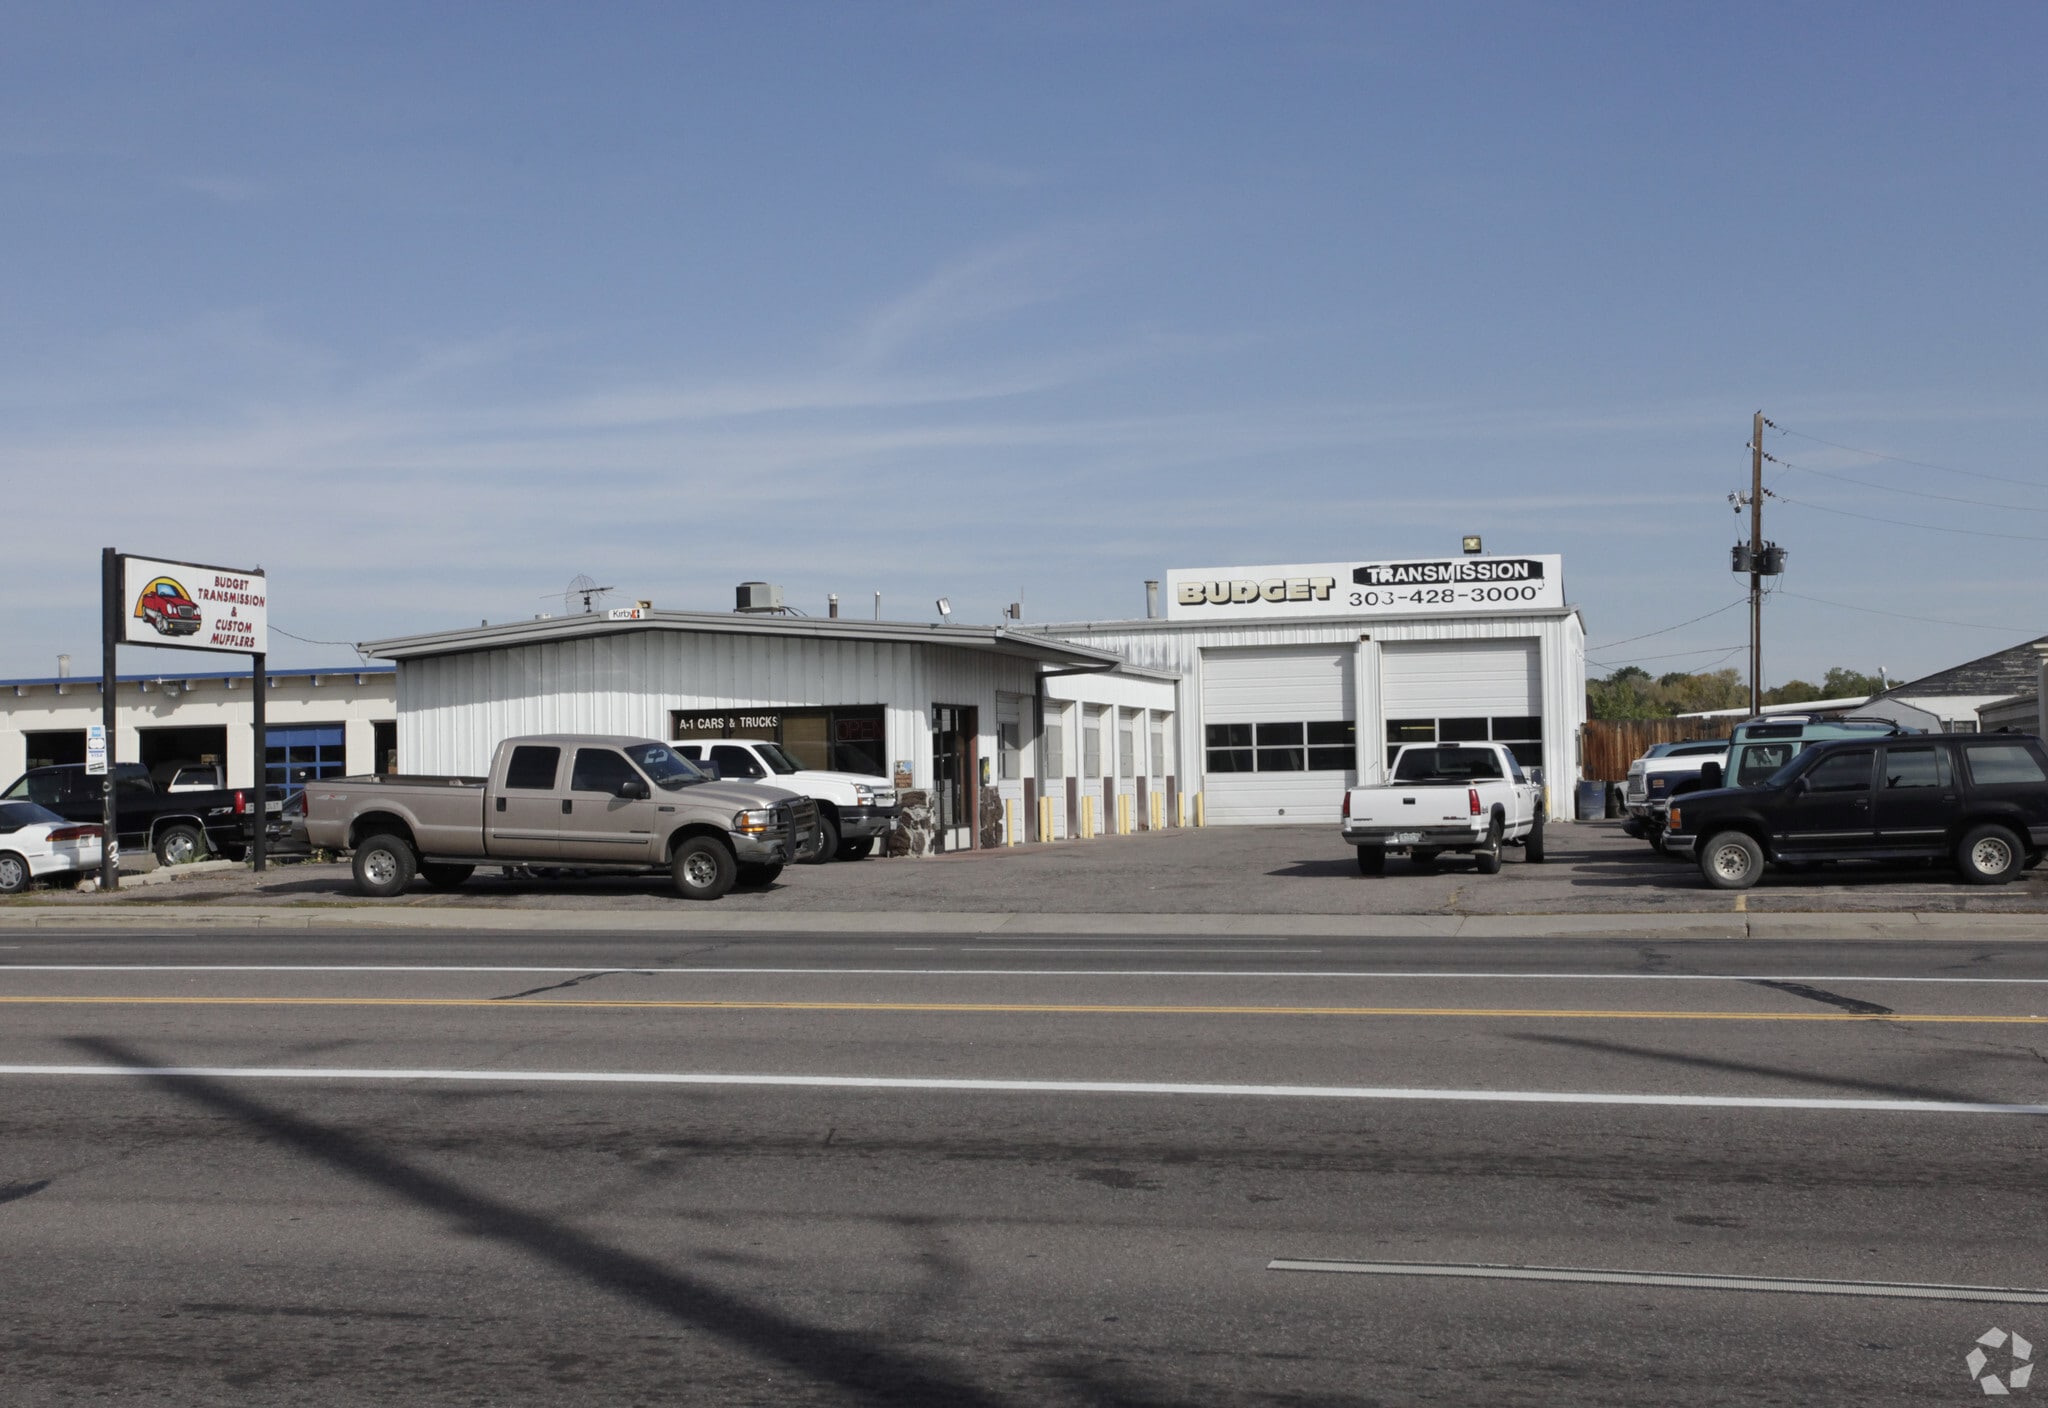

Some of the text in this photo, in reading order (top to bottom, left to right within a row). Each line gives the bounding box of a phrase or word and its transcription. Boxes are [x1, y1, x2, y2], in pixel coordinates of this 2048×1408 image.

[1367, 562, 1529, 584] TRANSMISSION
[214, 575, 249, 591] BUDGET
[1178, 577, 1336, 606] BUDGET
[198, 588, 266, 608] TRANSMISSION
[1349, 585, 1537, 607] 303-428-3000
[231, 606, 238, 617] &
[215, 619, 253, 634] CUSTOM
[210, 633, 256, 648] MUFFLERS
[680, 715, 779, 730] A-1 CARS & TRUCKS
[837, 720, 885, 740] OPEN
